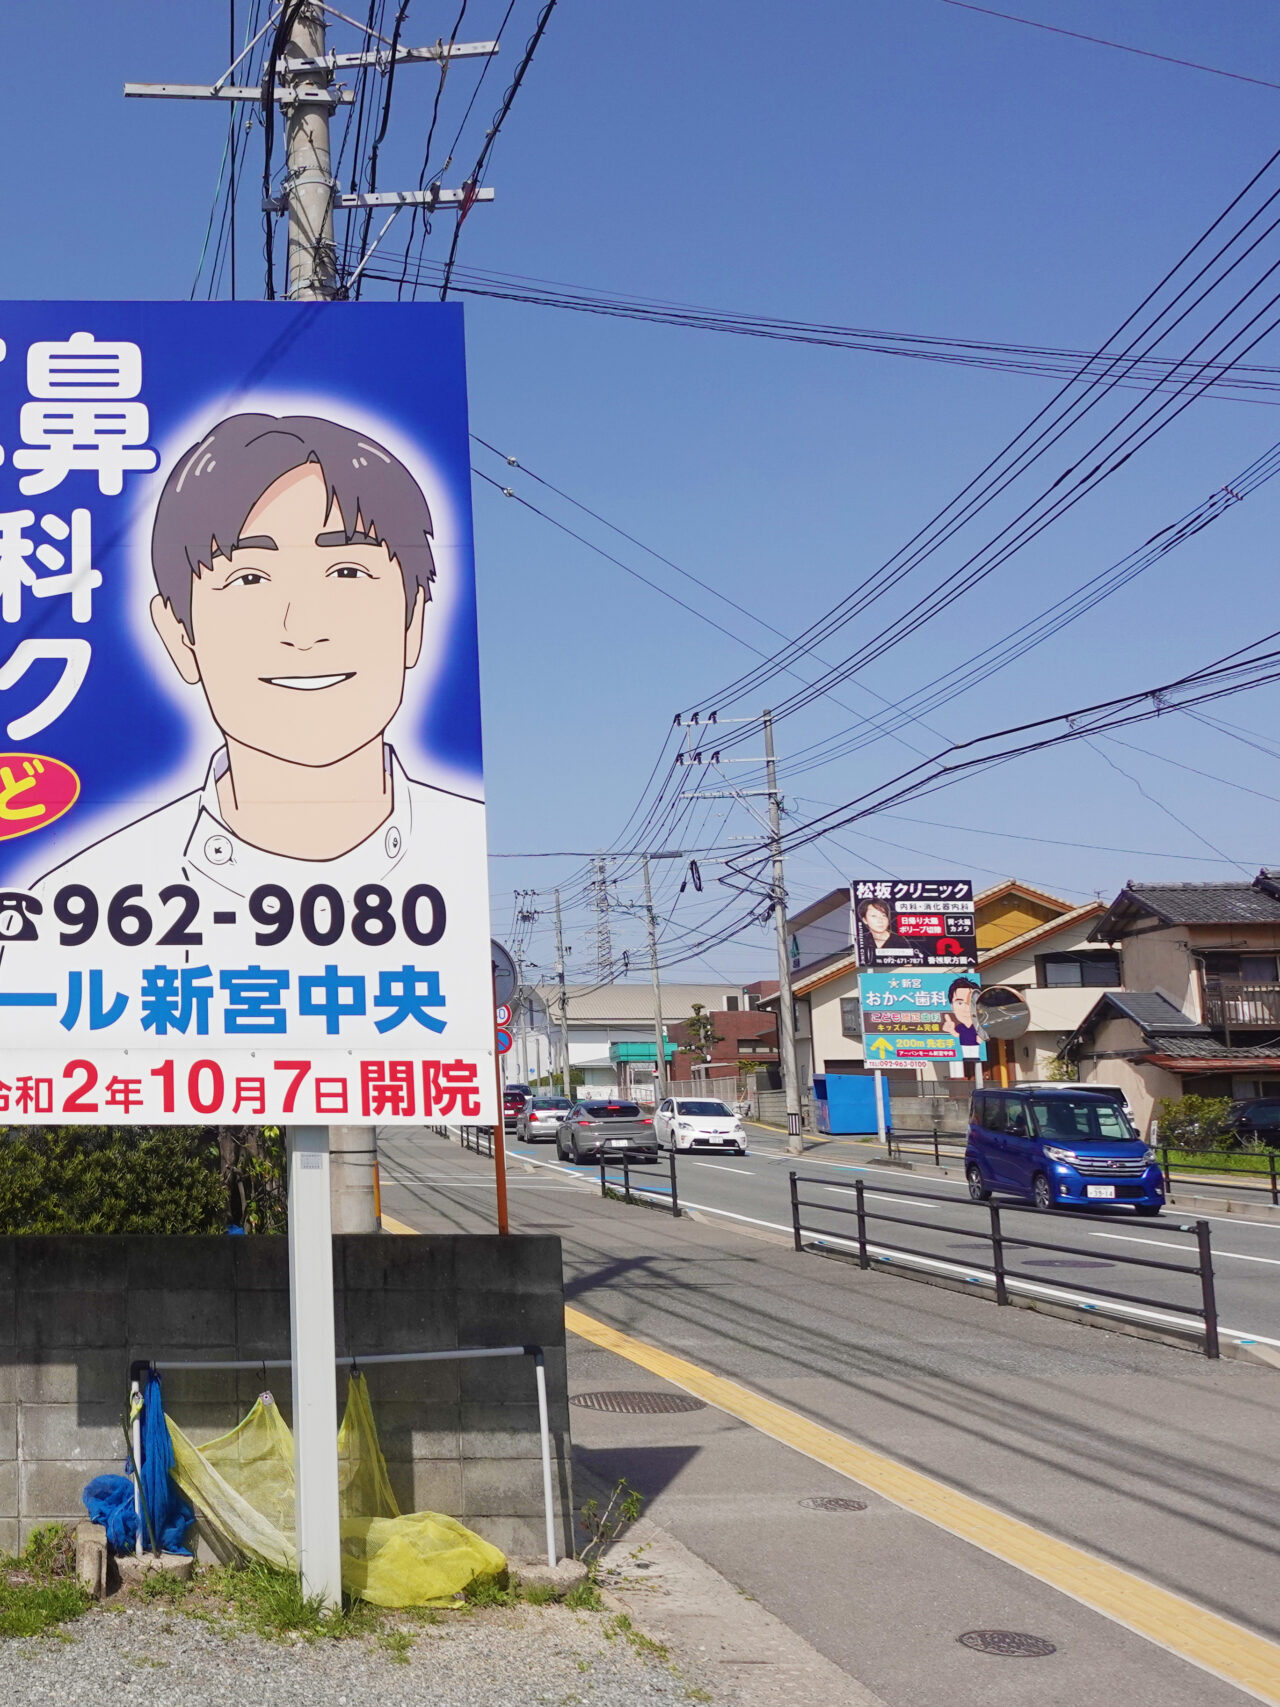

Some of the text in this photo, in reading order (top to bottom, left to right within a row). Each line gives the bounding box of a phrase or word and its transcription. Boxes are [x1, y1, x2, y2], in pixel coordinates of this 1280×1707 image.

[53, 883, 447, 947] 962-9080
[866, 991, 947, 1006] おかべ歯科
